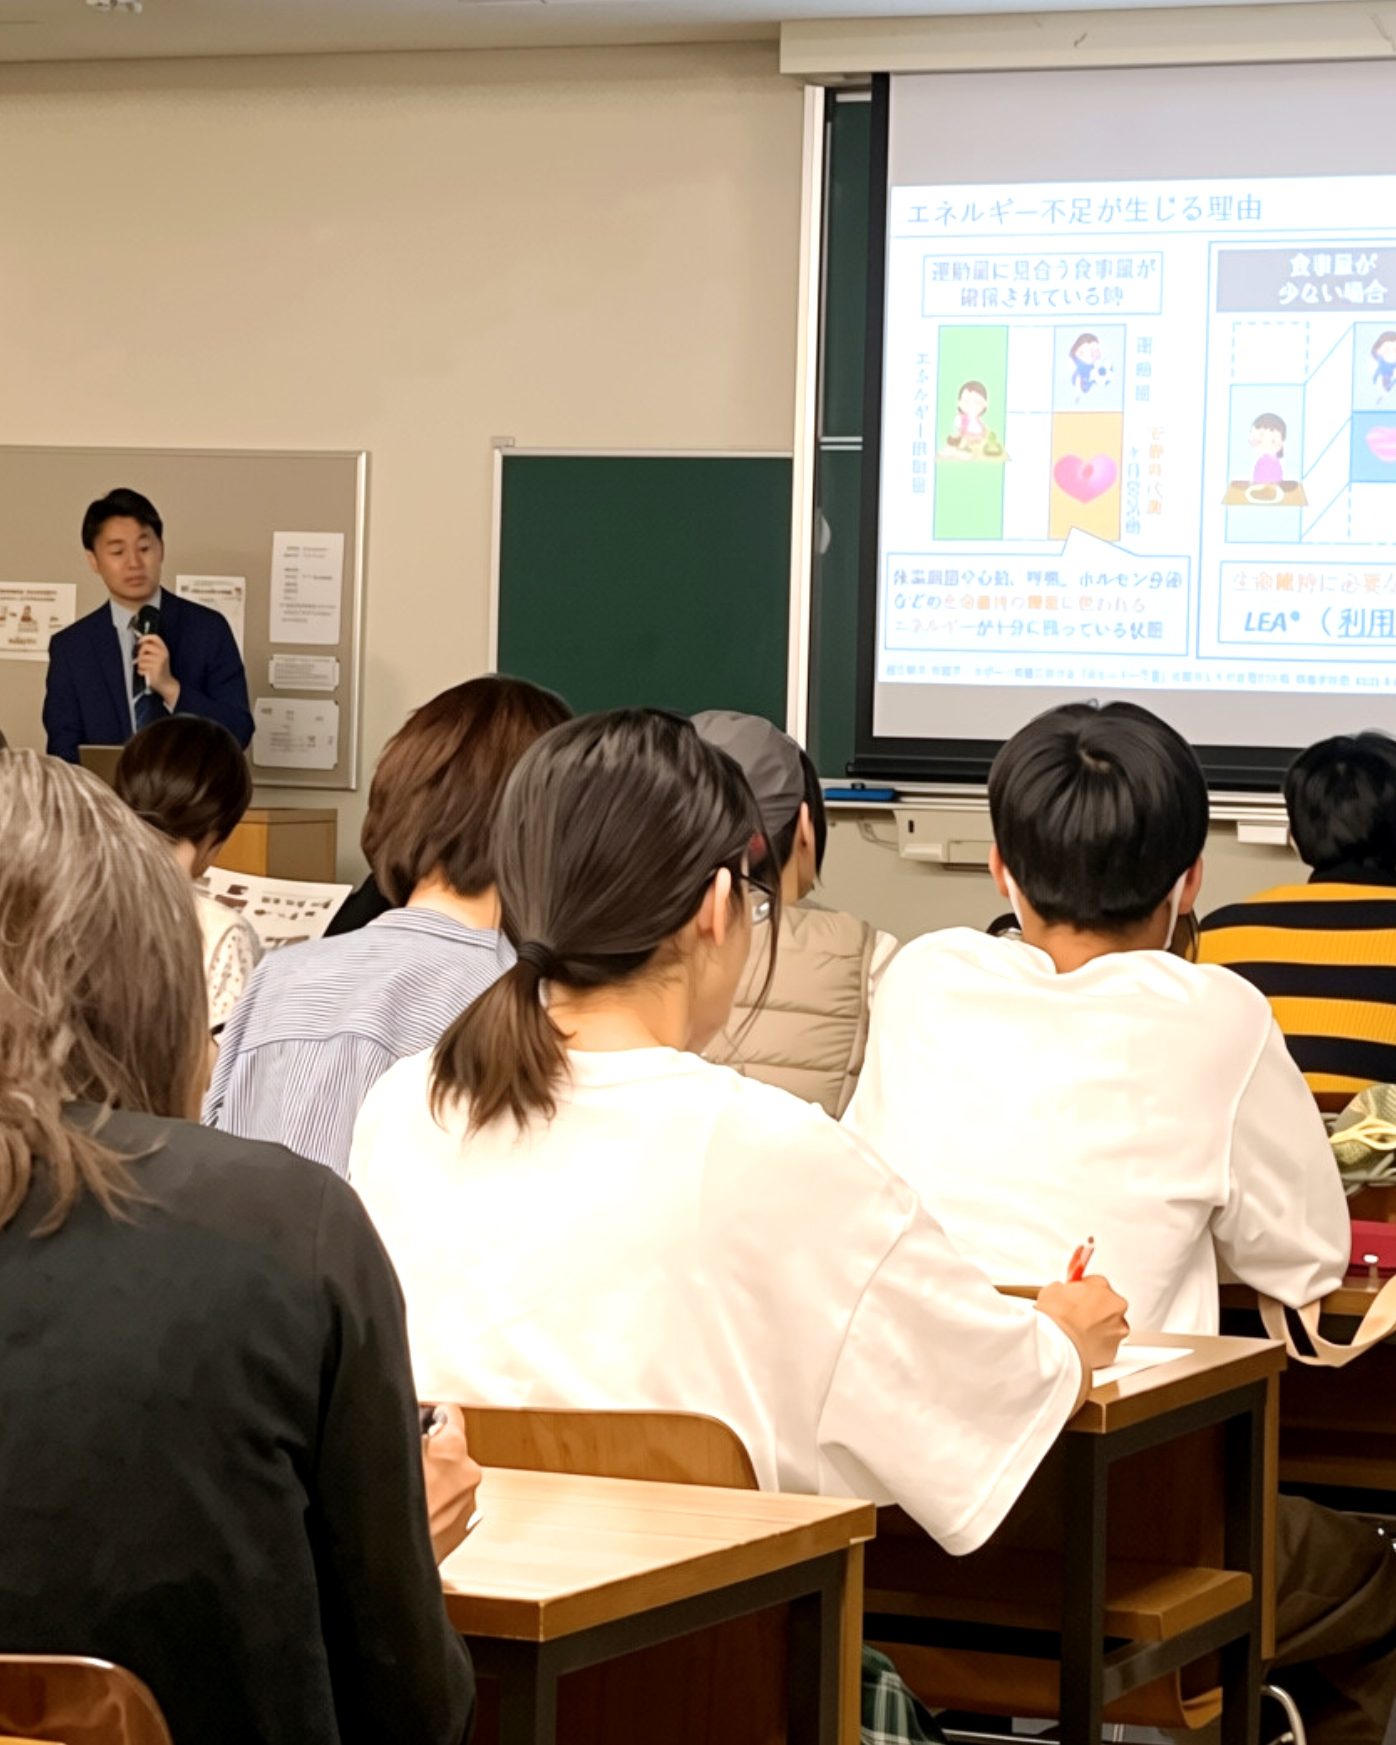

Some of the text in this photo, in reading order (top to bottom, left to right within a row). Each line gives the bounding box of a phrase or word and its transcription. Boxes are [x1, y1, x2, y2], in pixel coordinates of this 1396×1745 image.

[907, 193, 1263, 227] エネルギー不足が生じる理由
[1278, 278, 1388, 305] 少ない場合
